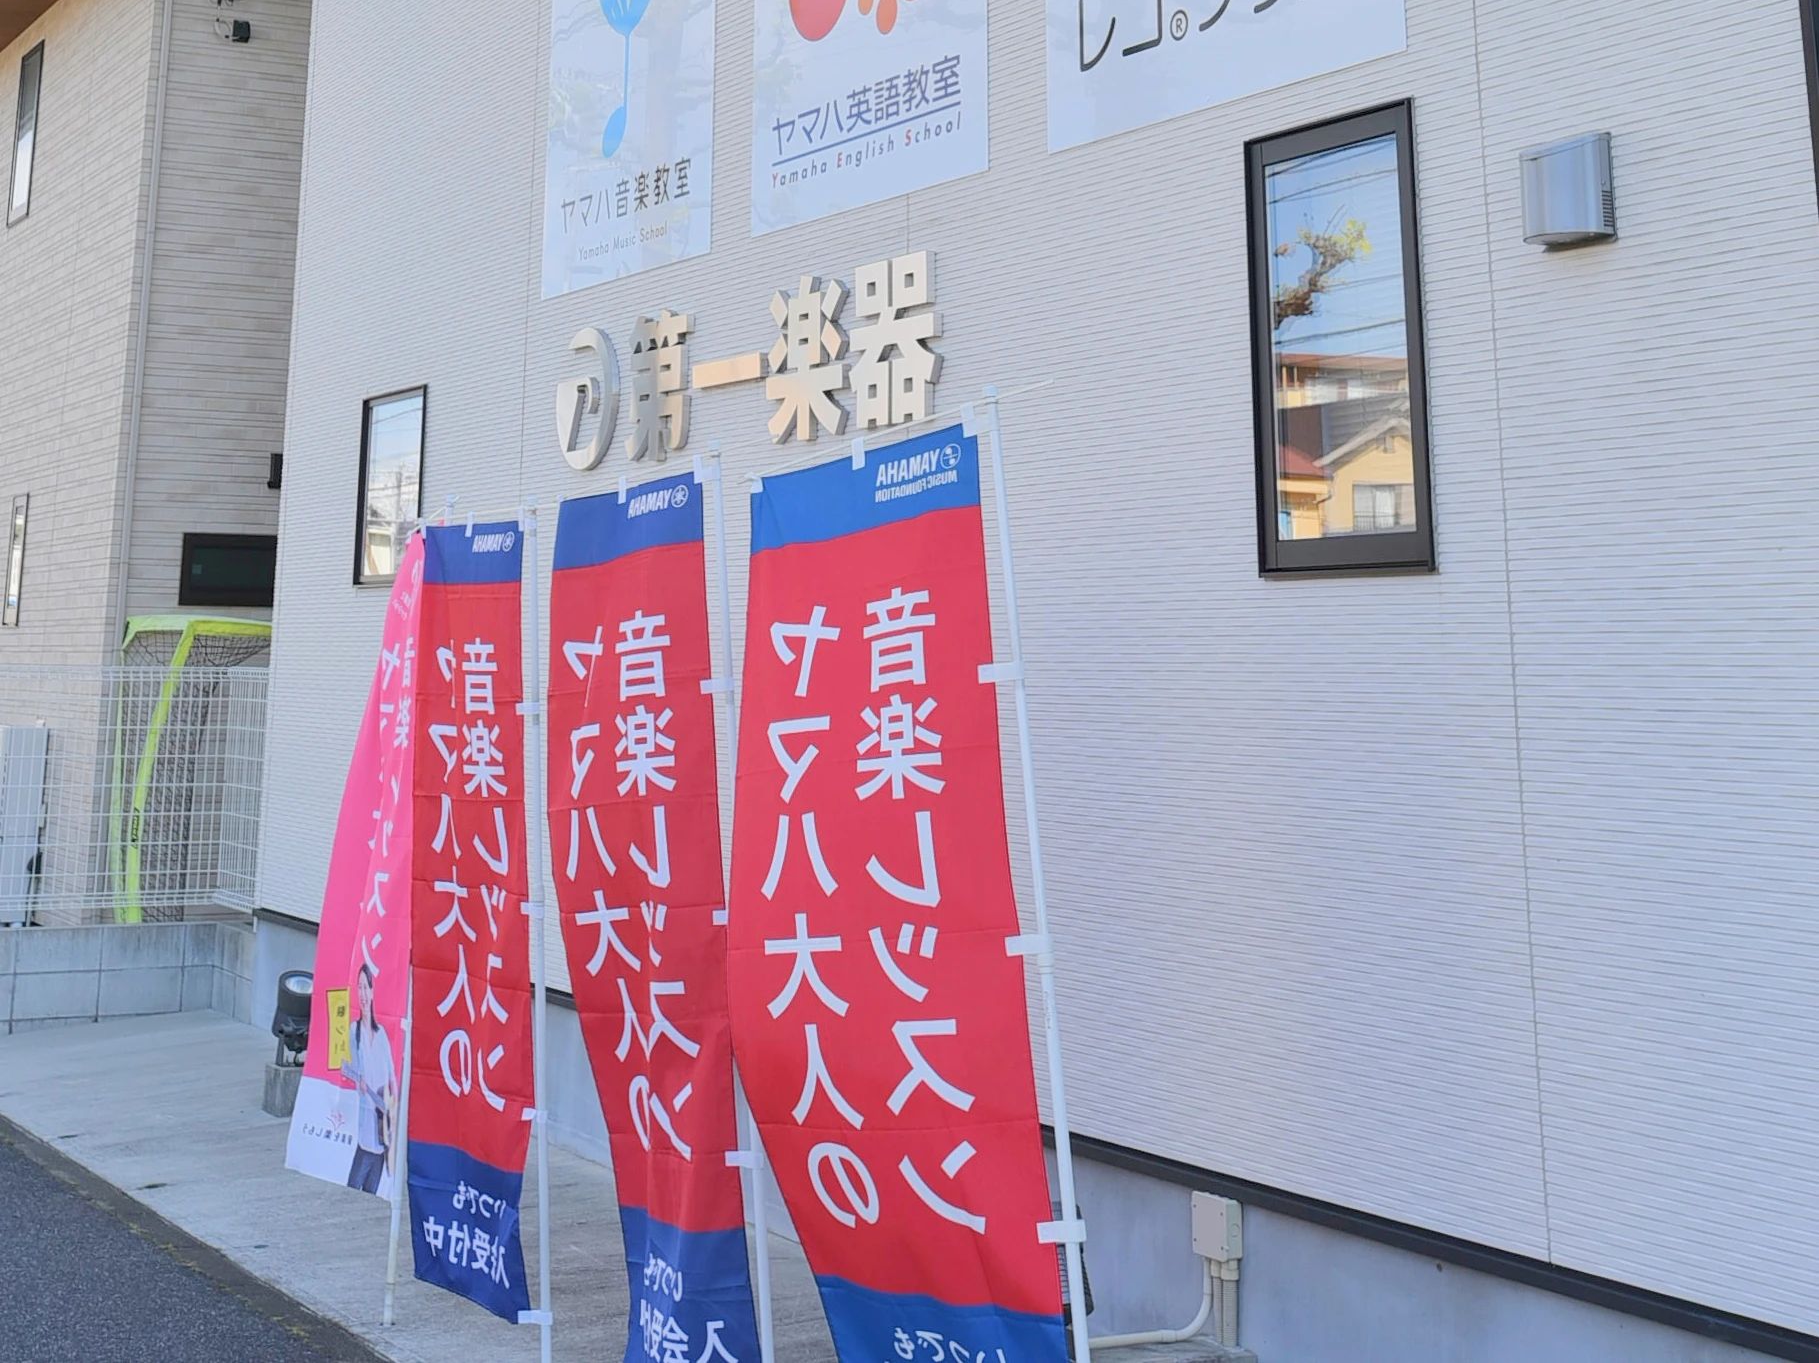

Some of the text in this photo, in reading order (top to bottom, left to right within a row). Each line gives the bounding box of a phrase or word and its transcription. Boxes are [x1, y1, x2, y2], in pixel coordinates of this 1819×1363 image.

[772, 54, 962, 156] ヤマハ英語教室
[772, 111, 961, 189] Yamaha English School
[561, 157, 691, 234] ヤマハ音楽教室
[578, 220, 668, 261] Yamaha Music School
[625, 250, 944, 463] 第一楽器
